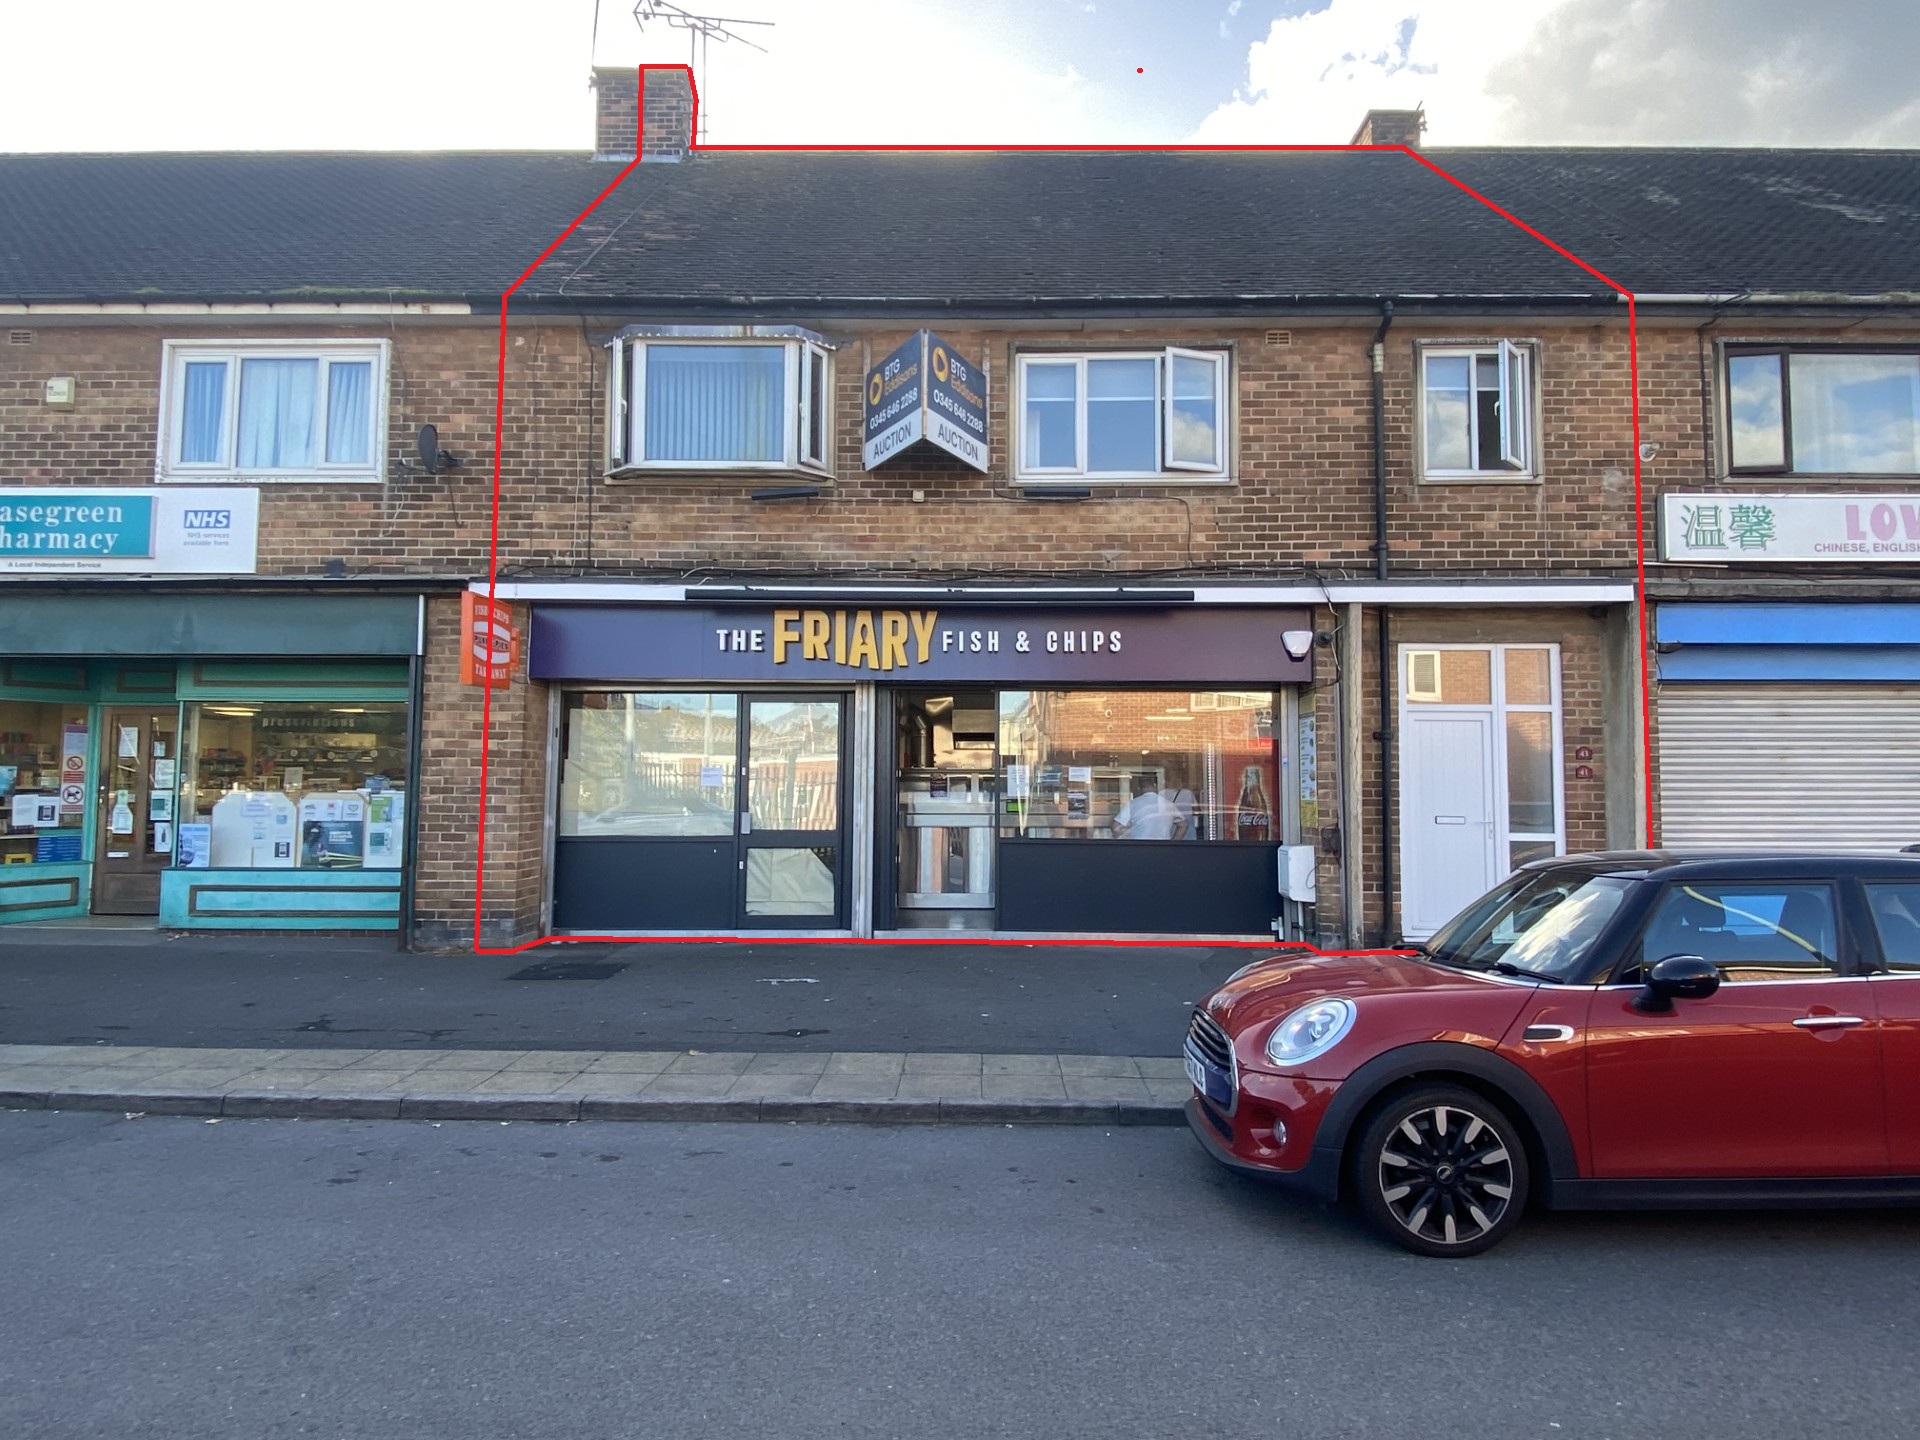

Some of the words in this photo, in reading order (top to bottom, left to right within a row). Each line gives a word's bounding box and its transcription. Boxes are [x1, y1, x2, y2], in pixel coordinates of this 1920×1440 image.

[885, 358, 900, 381] BTG
[950, 357, 967, 382] BTG
[869, 409, 887, 430] 0345
[886, 400, 900, 418] 646
[933, 388, 953, 413] 0345
[966, 411, 984, 433] 2288
[873, 421, 912, 460] AUCTION
[937, 423, 979, 461] AUCTION
[0, 505, 123, 528] asegreen
[184, 511, 230, 528] NHS
[1681, 503, 1778, 551] 温馨
[1845, 503, 1920, 541] LOV
[0, 525, 120, 554] harmacy
[1814, 543, 1870, 554] CHINESE,
[716, 629, 763, 651] THE
[773, 609, 938, 671] FRIARY
[942, 631, 999, 652] FISH
[1015, 631, 1030, 652] &
[1046, 631, 1122, 652] CHIPS
